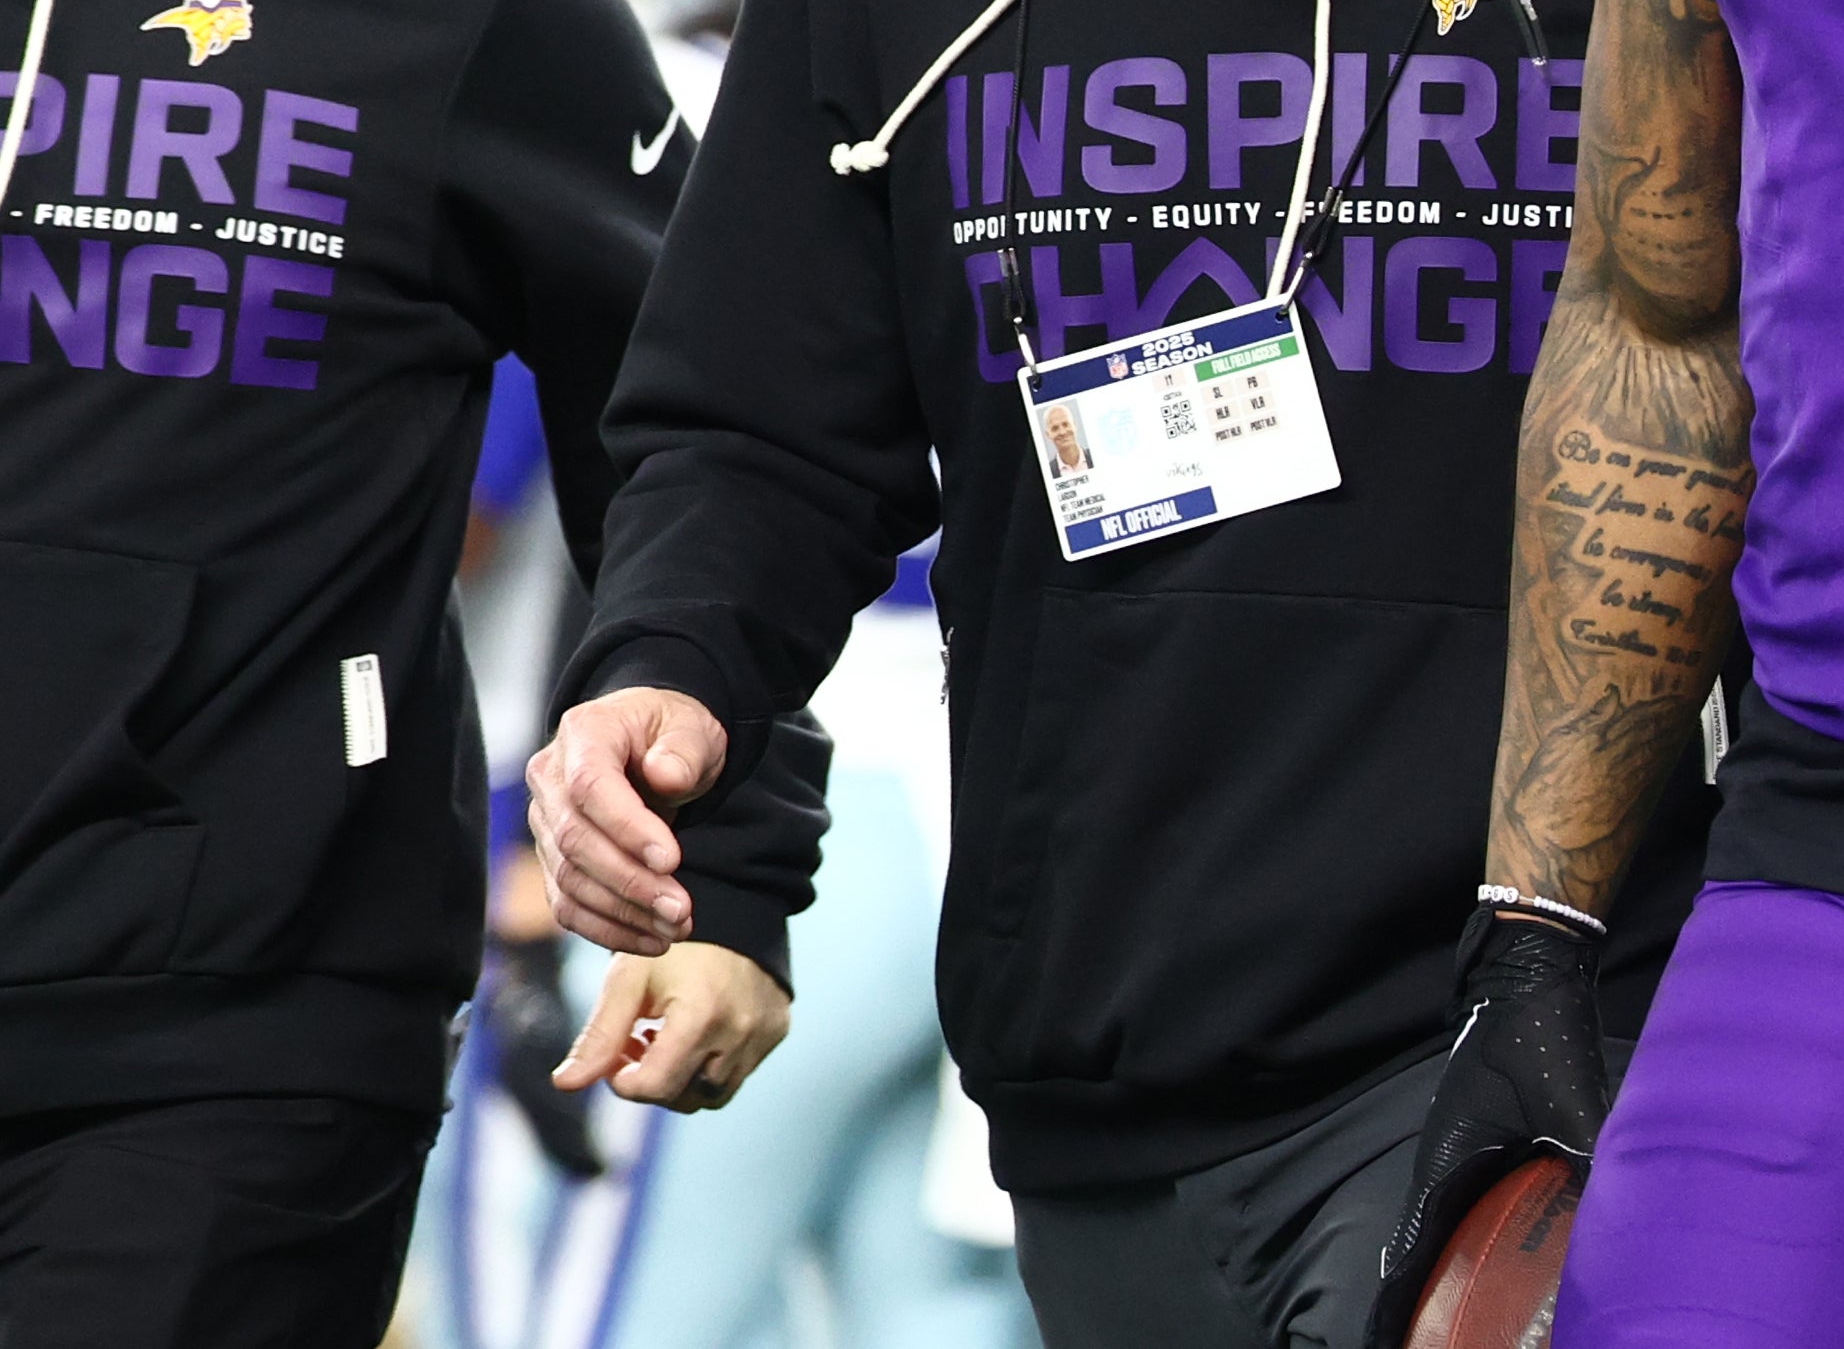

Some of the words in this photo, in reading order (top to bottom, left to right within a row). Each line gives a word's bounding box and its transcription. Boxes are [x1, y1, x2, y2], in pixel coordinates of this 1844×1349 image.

[945, 52, 1582, 208] INSPIRE
[34, 203, 178, 234] FREEDOM
[215, 217, 345, 259] JUSTICE
[1152, 201, 1262, 228] EQUITY
[1301, 201, 1441, 226] FEEDOM
[1482, 203, 1573, 229] JUSTI
[1131, 341, 1213, 375] SEASON
[1142, 331, 1195, 358] 2025
[1100, 514, 1128, 541] NFL
[1125, 499, 1183, 533] OFFICIAL
